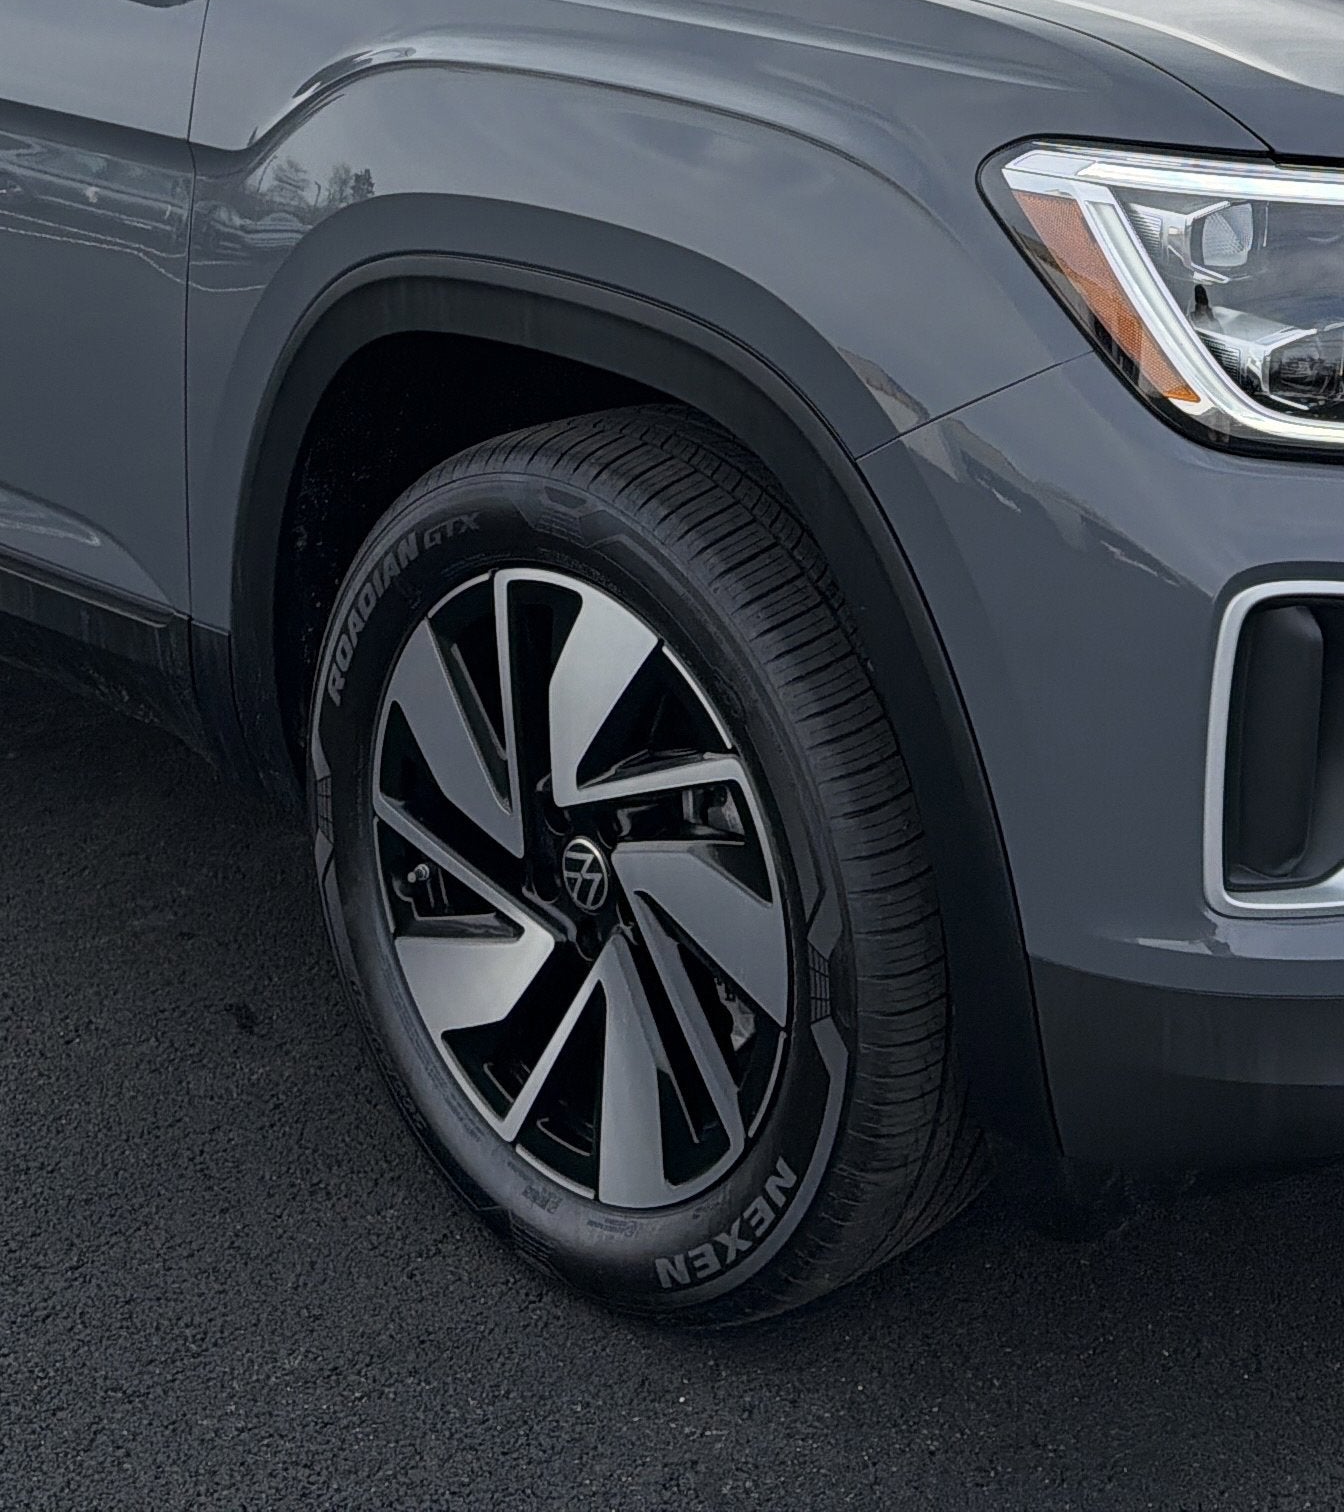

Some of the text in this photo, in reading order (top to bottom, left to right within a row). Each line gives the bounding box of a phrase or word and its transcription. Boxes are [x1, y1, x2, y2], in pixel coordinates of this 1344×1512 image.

[327, 531, 419, 707] ROADIAN
[423, 512, 481, 550] GTX
[562, 838, 608, 910] VW
[655, 1155, 798, 1289] NEXEN
